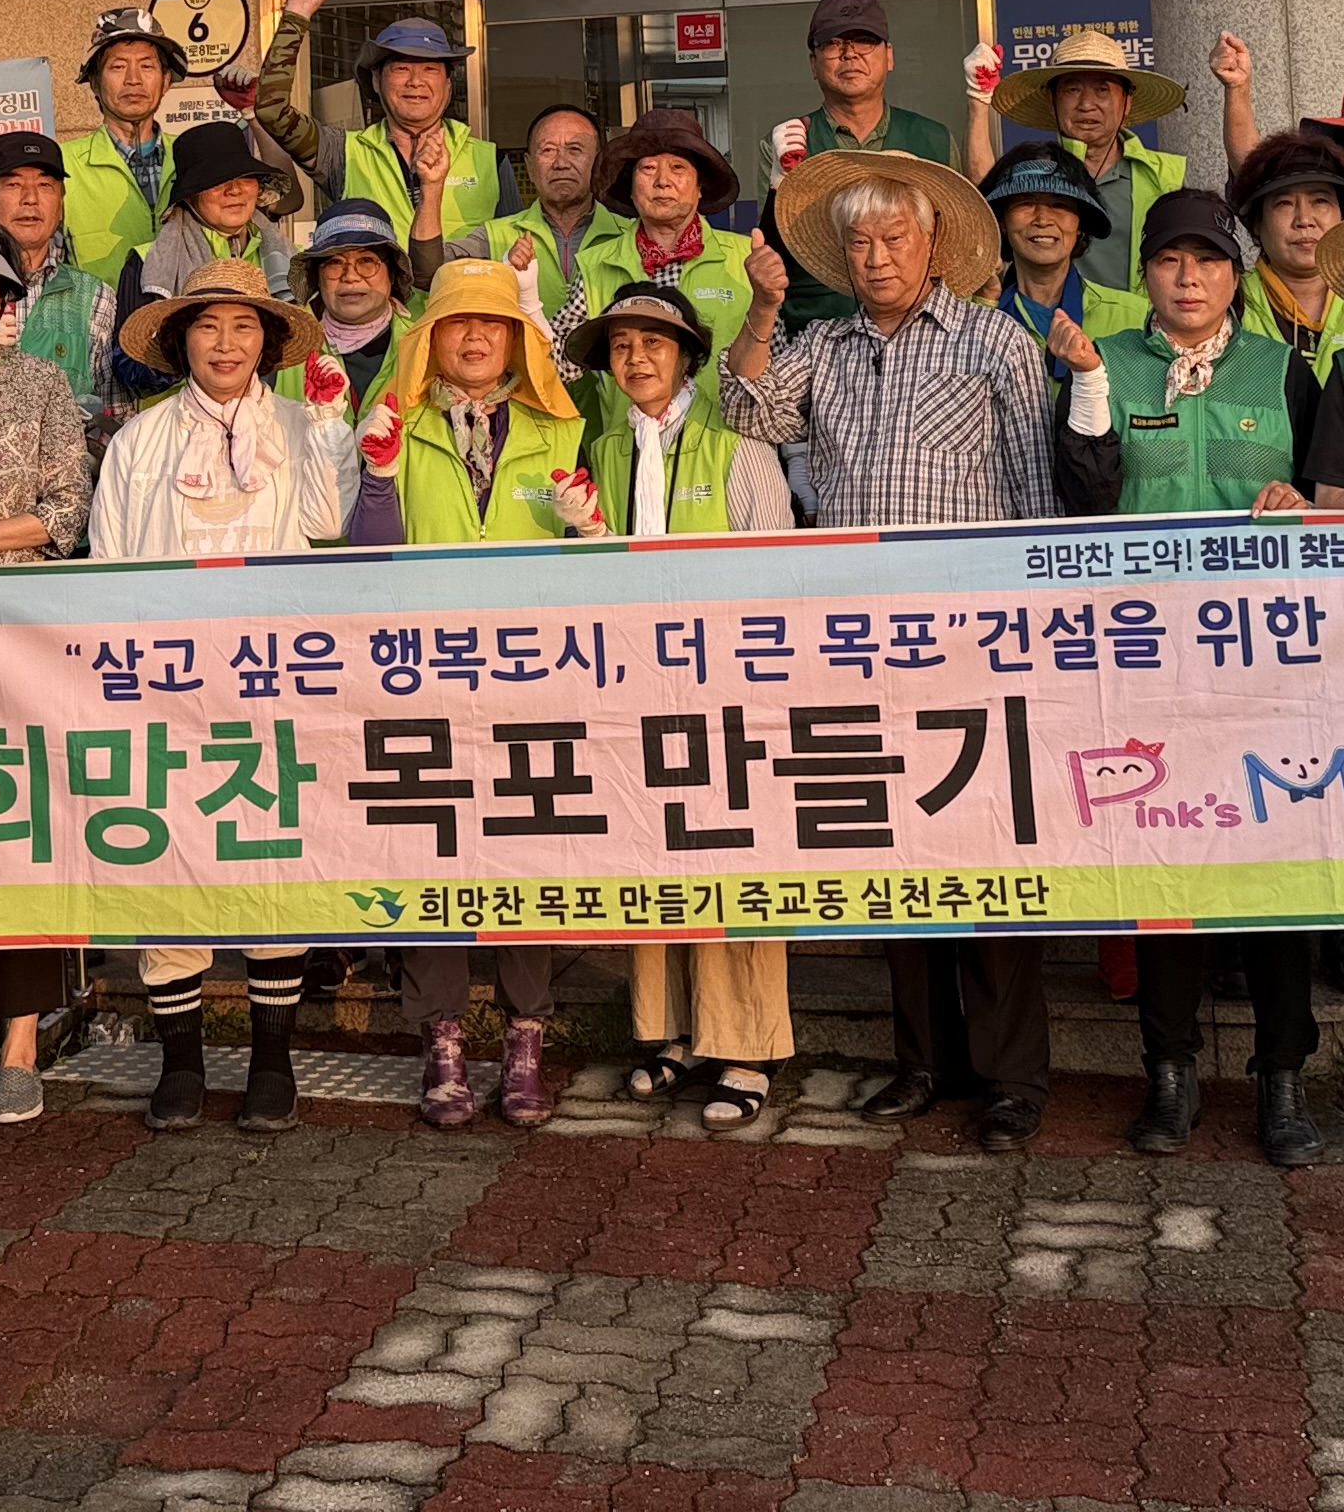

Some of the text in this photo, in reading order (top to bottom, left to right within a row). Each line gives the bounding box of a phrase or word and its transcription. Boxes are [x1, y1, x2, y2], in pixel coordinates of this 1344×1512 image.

[184, 43, 230, 57] 로81번길
[188, 12, 209, 43] 6
[1012, 26, 1033, 39] 민원
[1118, 19, 1139, 34] 위한
[1025, 542, 1114, 580] 희망찬
[1123, 539, 1193, 575] 도약!
[1200, 534, 1290, 572] 청년이
[229, 631, 344, 699] 싶은
[369, 622, 626, 696] 행복도시,
[655, 617, 707, 685] 더
[734, 615, 795, 683] 큰
[1196, 595, 1327, 668] 위한
[348, 719, 608, 857] 목포
[641, 696, 1037, 851] 만들기
[418, 875, 1050, 928] 희망찬 목포 만들기 죽교동 실천추진단
